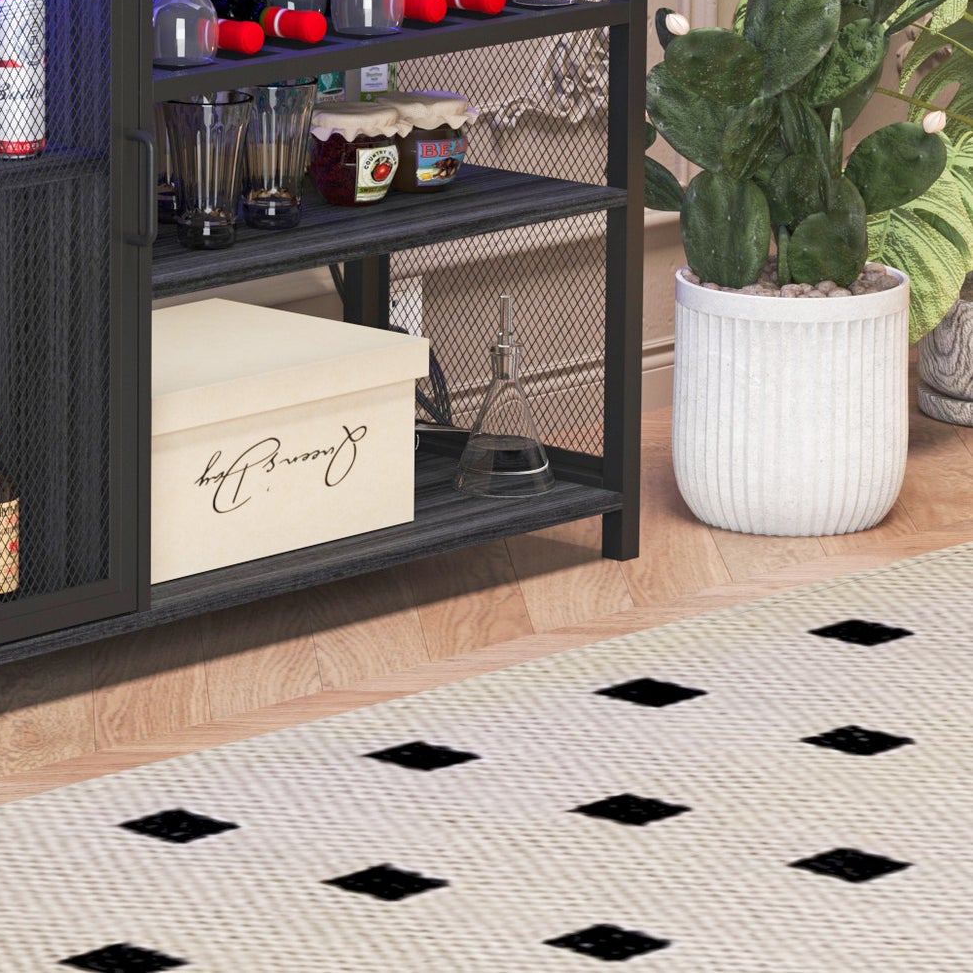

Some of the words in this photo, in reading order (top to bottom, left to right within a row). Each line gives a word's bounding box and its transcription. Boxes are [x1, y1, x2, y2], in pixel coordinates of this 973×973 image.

[364, 149, 387, 170] COUNTRY
[193, 437, 281, 514] Day
[262, 425, 367, 491] Queen's
